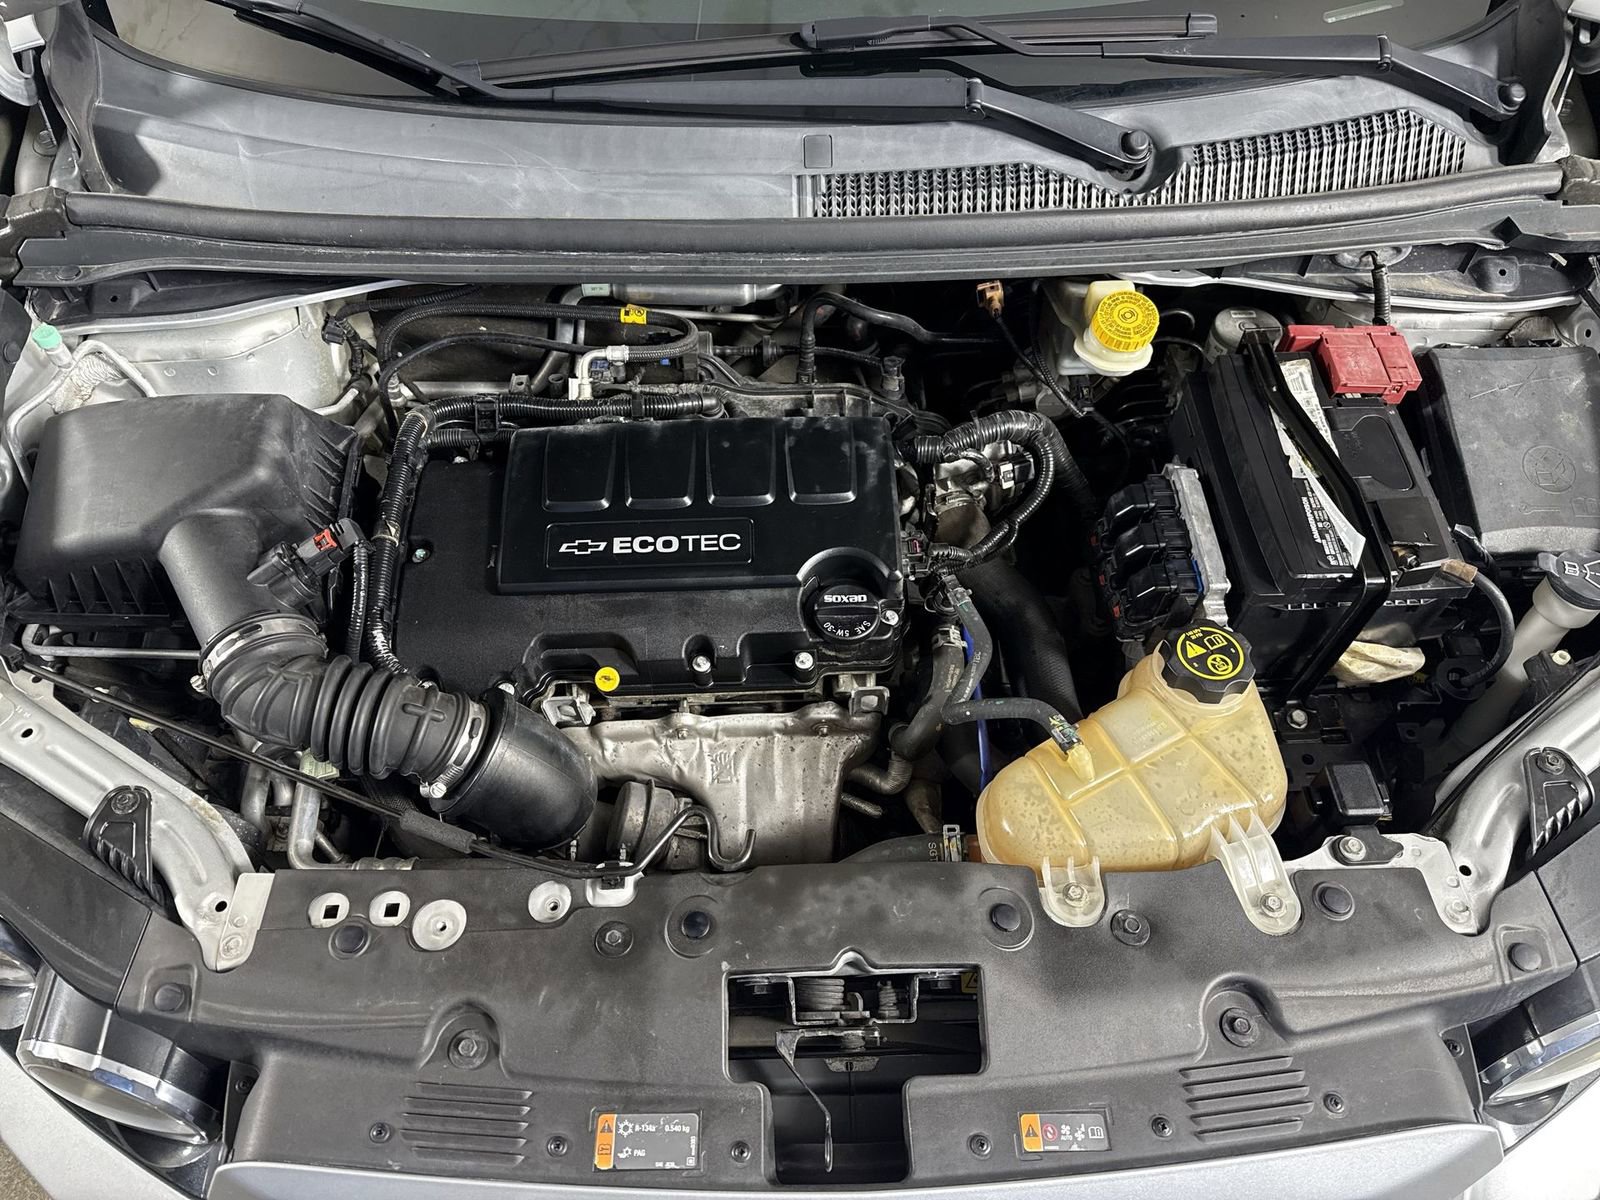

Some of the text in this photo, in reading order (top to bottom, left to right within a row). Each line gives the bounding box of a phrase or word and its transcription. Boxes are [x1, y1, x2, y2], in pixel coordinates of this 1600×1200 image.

[613, 534, 741, 554] ECOTEC
[823, 594, 867, 603] dexos
[823, 620, 871, 637] SAE 5W-30
[633, 1149, 646, 1157] PAG
